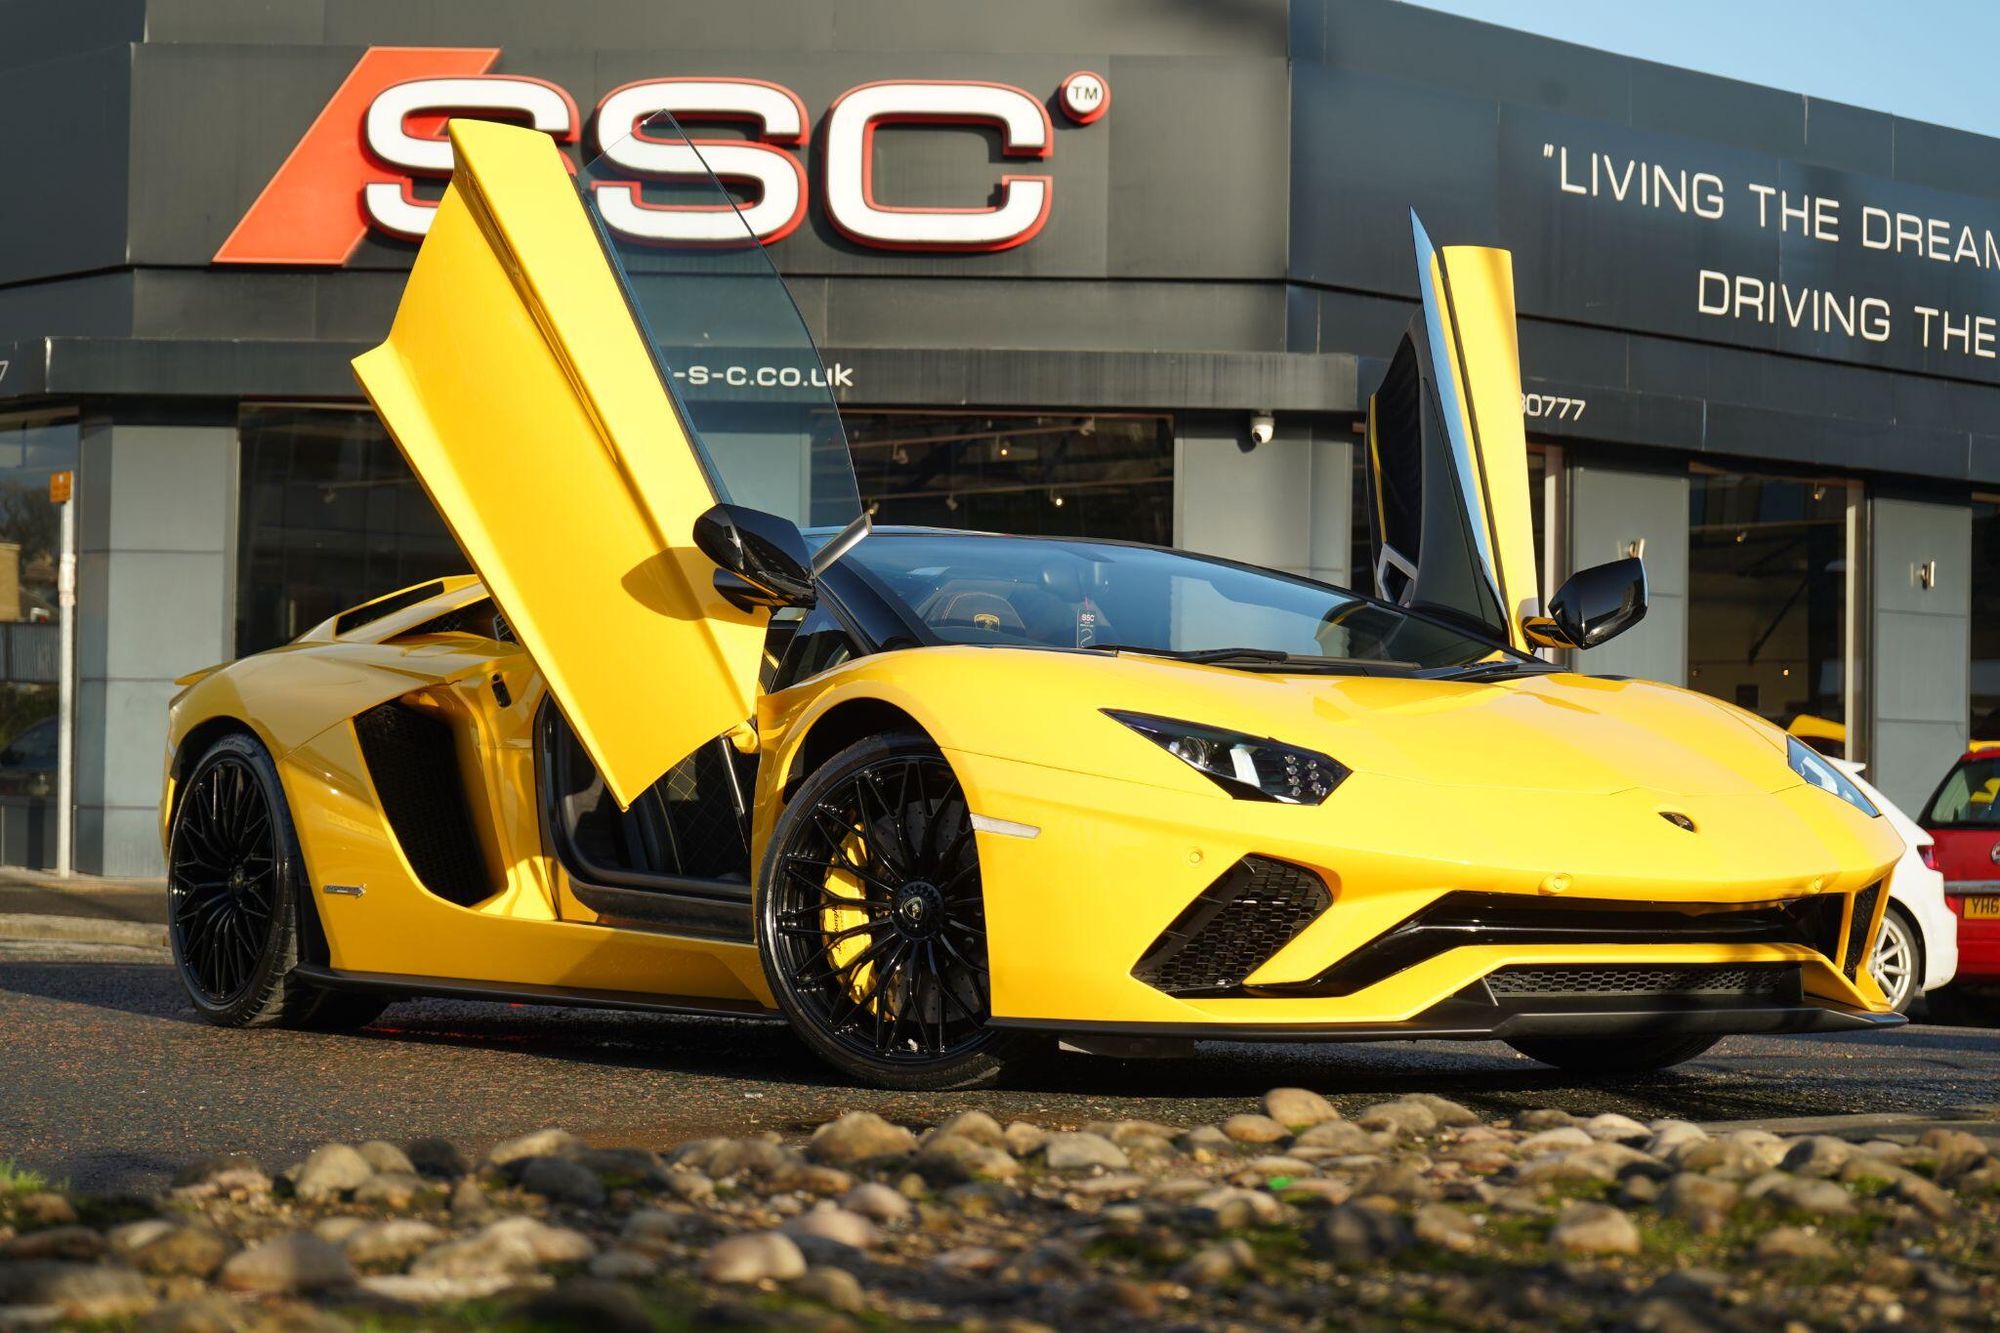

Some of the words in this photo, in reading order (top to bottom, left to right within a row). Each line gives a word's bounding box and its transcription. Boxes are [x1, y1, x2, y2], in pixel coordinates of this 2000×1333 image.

[1072, 86, 1098, 100] TM
[363, 78, 1053, 253] SSC
[1748, 183, 1840, 242] THE
[1698, 269, 1891, 342] DRIVING
[1914, 305, 1997, 358] THE
